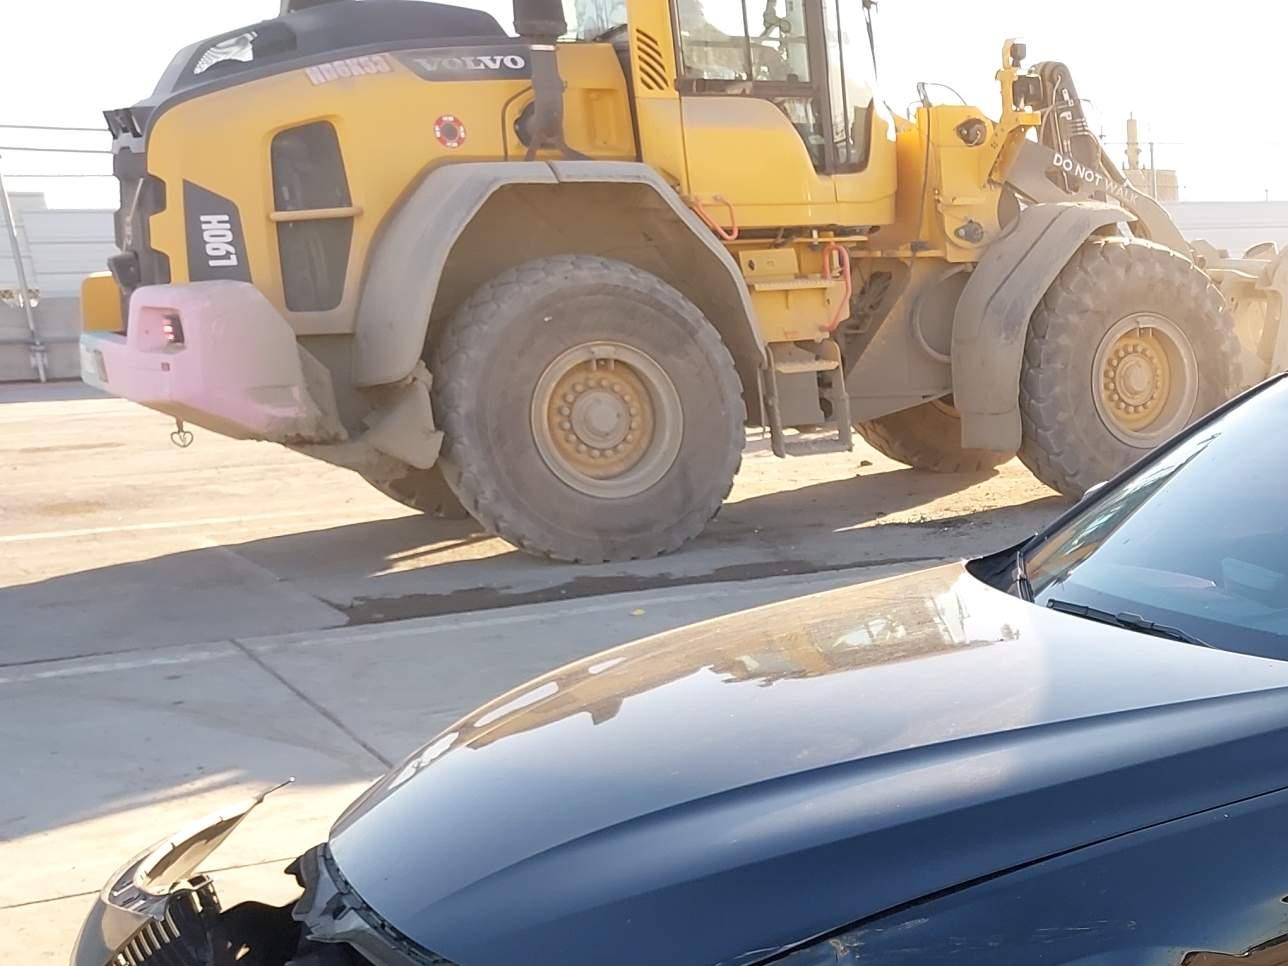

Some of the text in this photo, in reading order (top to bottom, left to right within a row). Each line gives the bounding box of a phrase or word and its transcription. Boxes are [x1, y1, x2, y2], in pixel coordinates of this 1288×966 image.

[415, 54, 526, 72] VOLVO
[1053, 153, 1140, 204] DO NOT WALK
[200, 214, 239, 267] L90H
